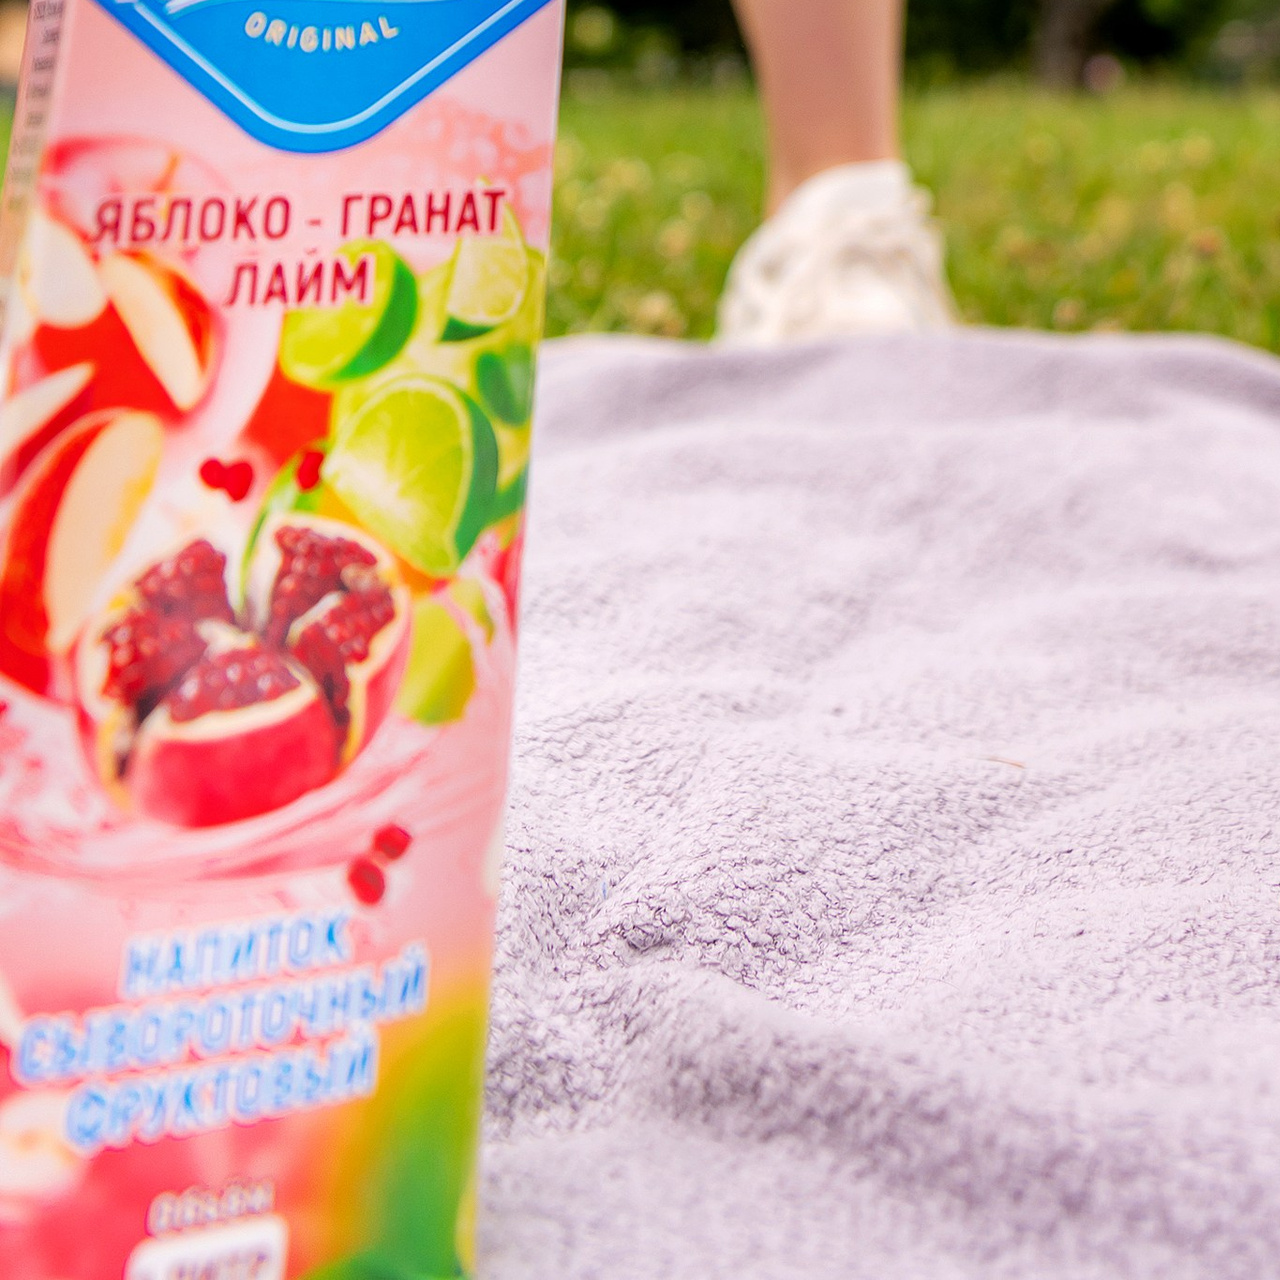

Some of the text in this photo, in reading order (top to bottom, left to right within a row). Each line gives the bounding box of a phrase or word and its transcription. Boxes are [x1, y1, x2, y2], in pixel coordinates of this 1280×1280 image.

[244, 10, 399, 53] ORIGINAL
[94, 194, 290, 243] ЯБЛОКО
[341, 189, 506, 238] ГРАНАТ
[224, 247, 370, 307] ЛАЙМ
[123, 909, 352, 998] НАПИТОК
